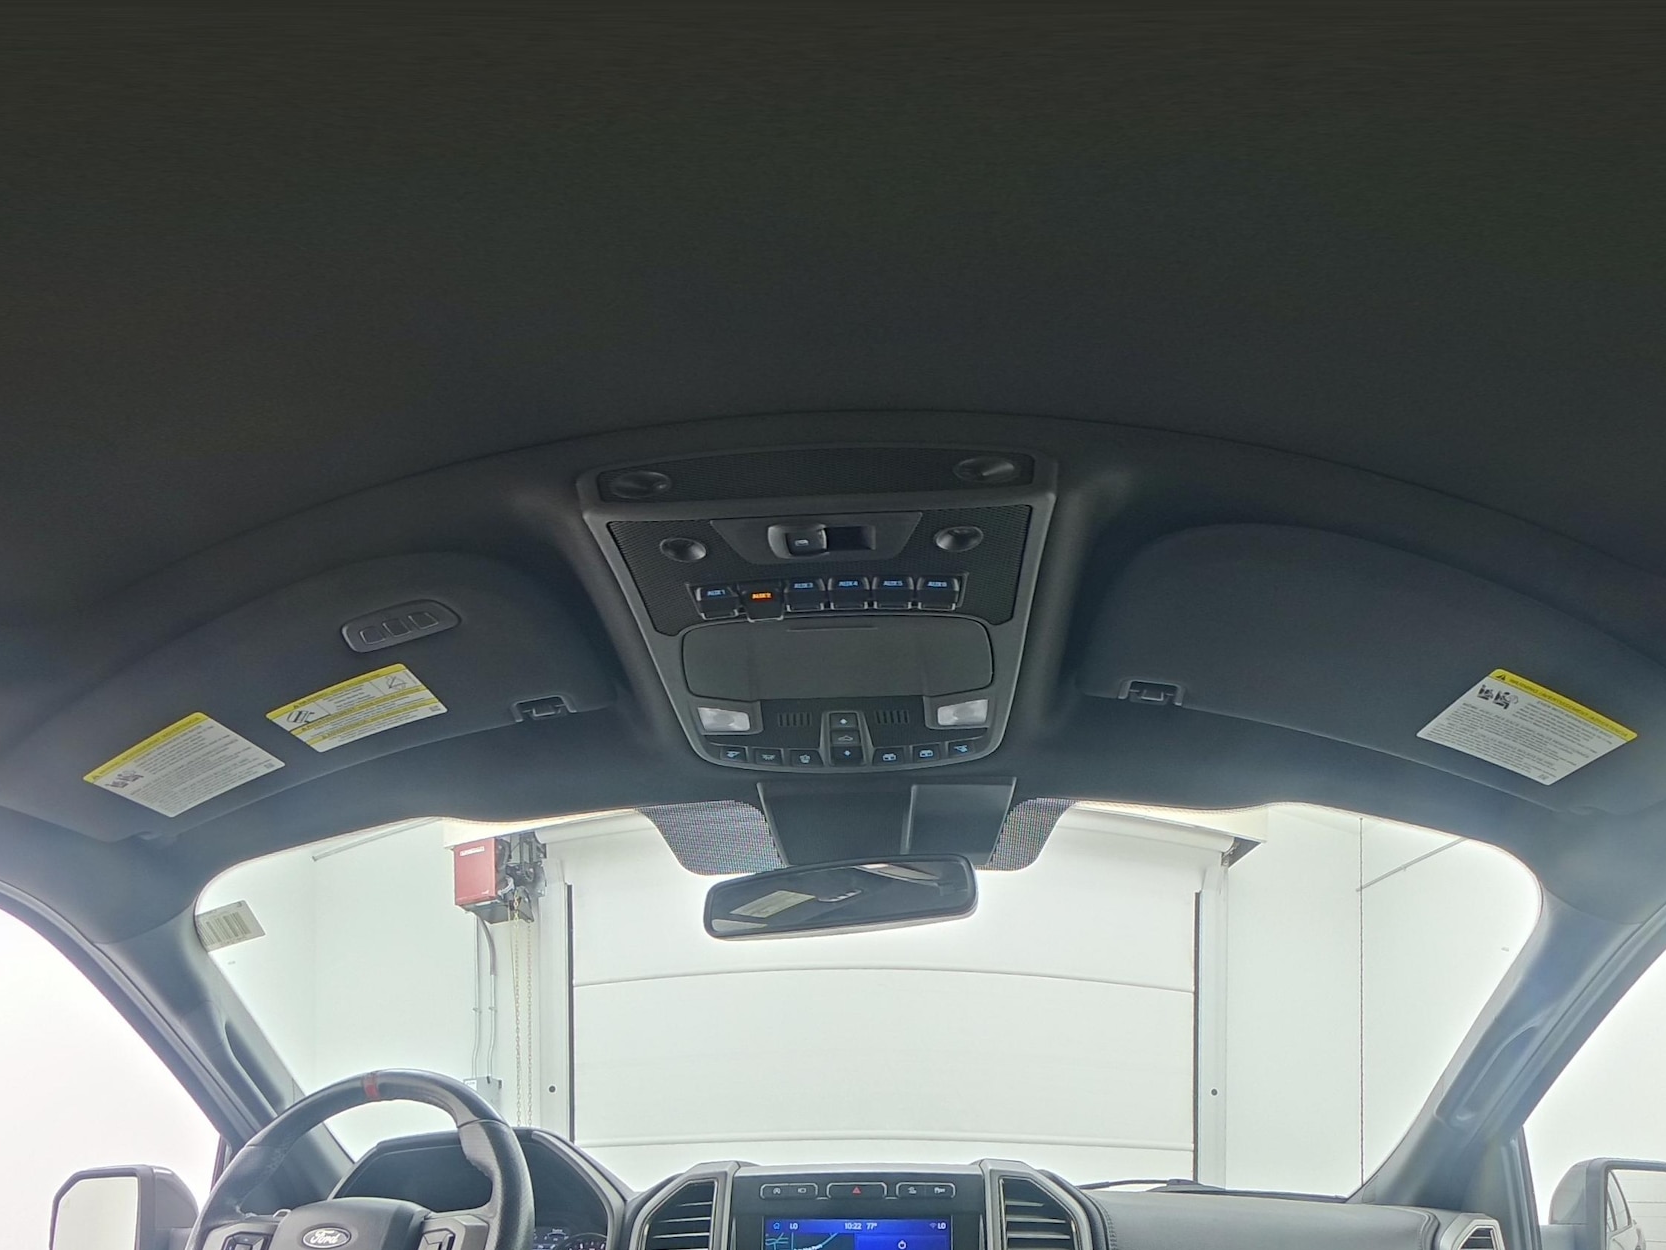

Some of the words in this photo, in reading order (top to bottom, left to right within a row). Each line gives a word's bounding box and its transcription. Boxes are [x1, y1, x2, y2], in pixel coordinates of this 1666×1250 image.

[844, 1222, 862, 1230] 10:22
[937, 1222, 946, 1230] LO
[309, 1229, 341, 1244] Ford
